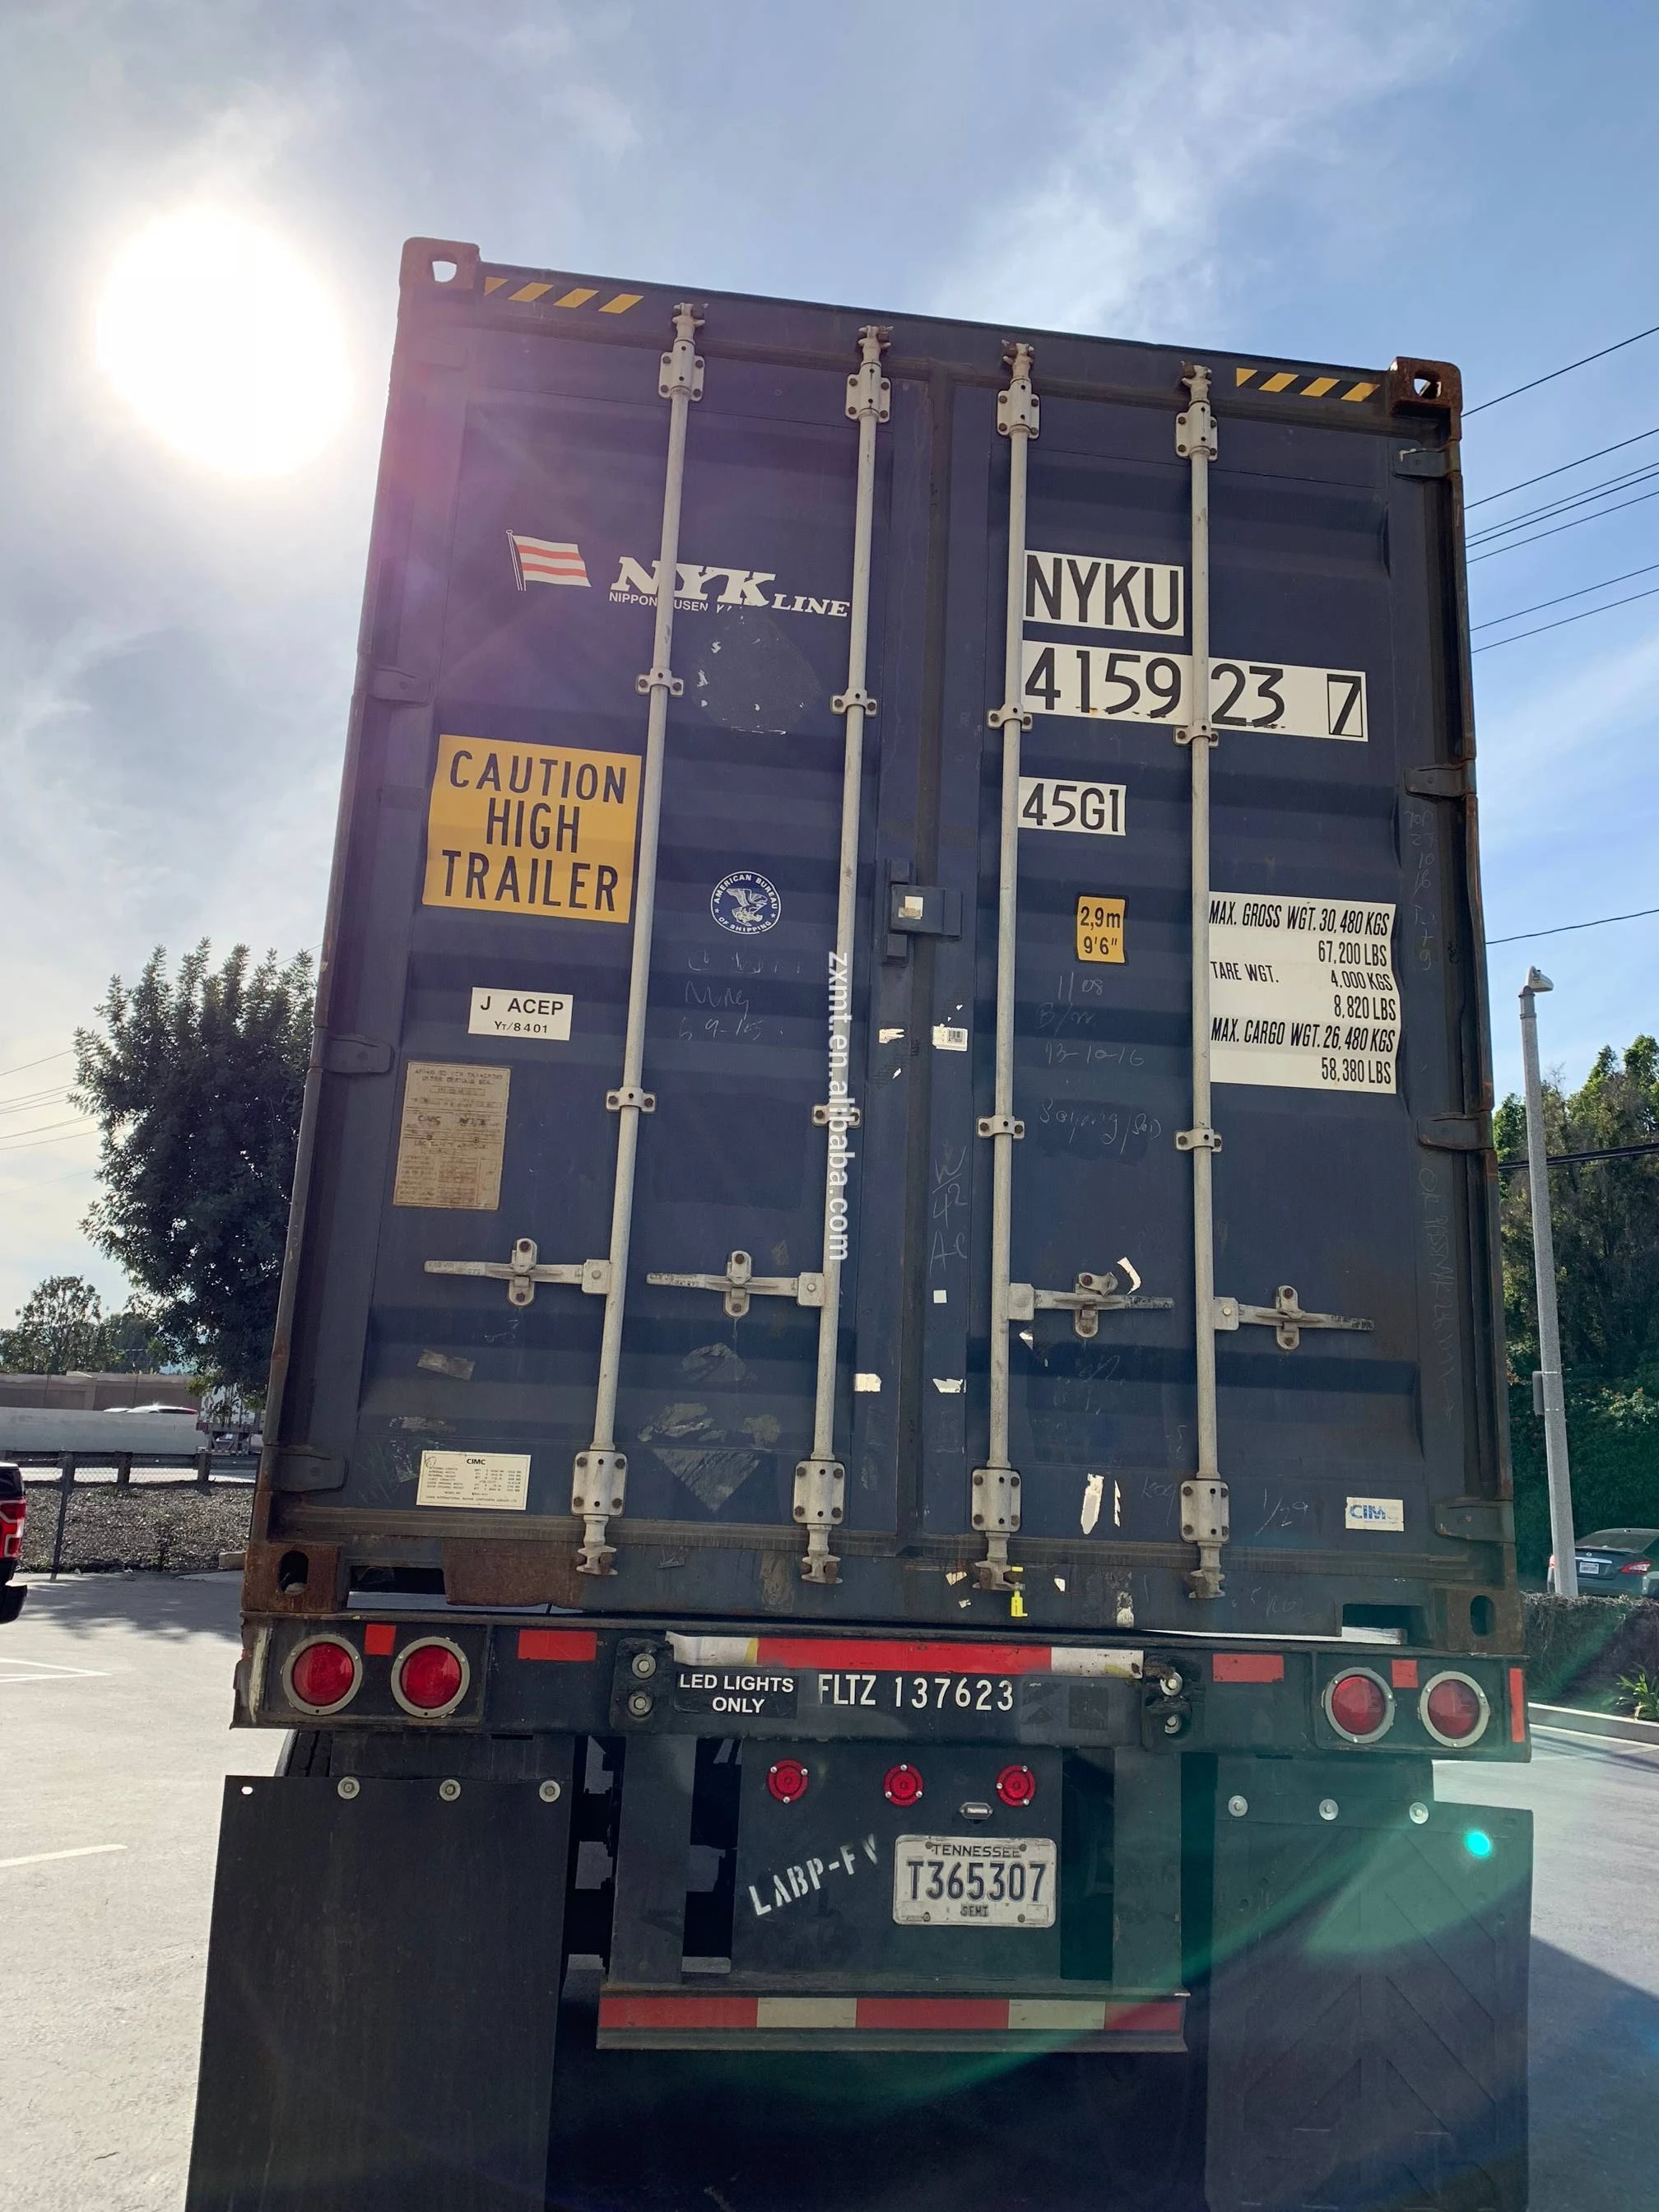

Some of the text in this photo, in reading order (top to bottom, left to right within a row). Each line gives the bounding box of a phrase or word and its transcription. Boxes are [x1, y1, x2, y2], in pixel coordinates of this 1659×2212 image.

[609, 591, 658, 607] NIPPON
[673, 599, 709, 612] USEN
[611, 556, 850, 617] NYK LINE
[1025, 554, 1179, 630] NYKU
[1327, 673, 1363, 737] 7
[449, 750, 627, 805] CAUTION
[1022, 782, 1119, 832] 45G1
[486, 797, 580, 853] HIGH
[442, 848, 619, 912] TRAILER
[713, 874, 778, 909] AMERICAN BUREAU
[718, 917, 772, 932] OF SHIPPING
[1208, 900, 1390, 936] MAX. GROSS WGT. 30,480 KGS
[1317, 940, 1387, 967] 67,200 LBS
[1210, 960, 1243, 981] TARE
[1244, 963, 1280, 983] WGT.
[1367, 972, 1394, 992] KGS
[480, 996, 564, 1015] J ACEP
[1333, 994, 1396, 1021] 8,820 LBS
[1211, 1016, 1396, 1053] MAX. CARGO WGT. 26,480 KGS
[1321, 1057, 1392, 1085] 58,380 LBS
[1350, 1504, 1396, 1520] CIM
[680, 1673, 795, 1694] LED LIGHTS
[818, 1674, 1015, 1712] FLTZ 137623
[712, 1696, 765, 1714] ONLY
[932, 1843, 1022, 1858] TENNESSEE
[907, 1860, 1049, 1903] T365307
